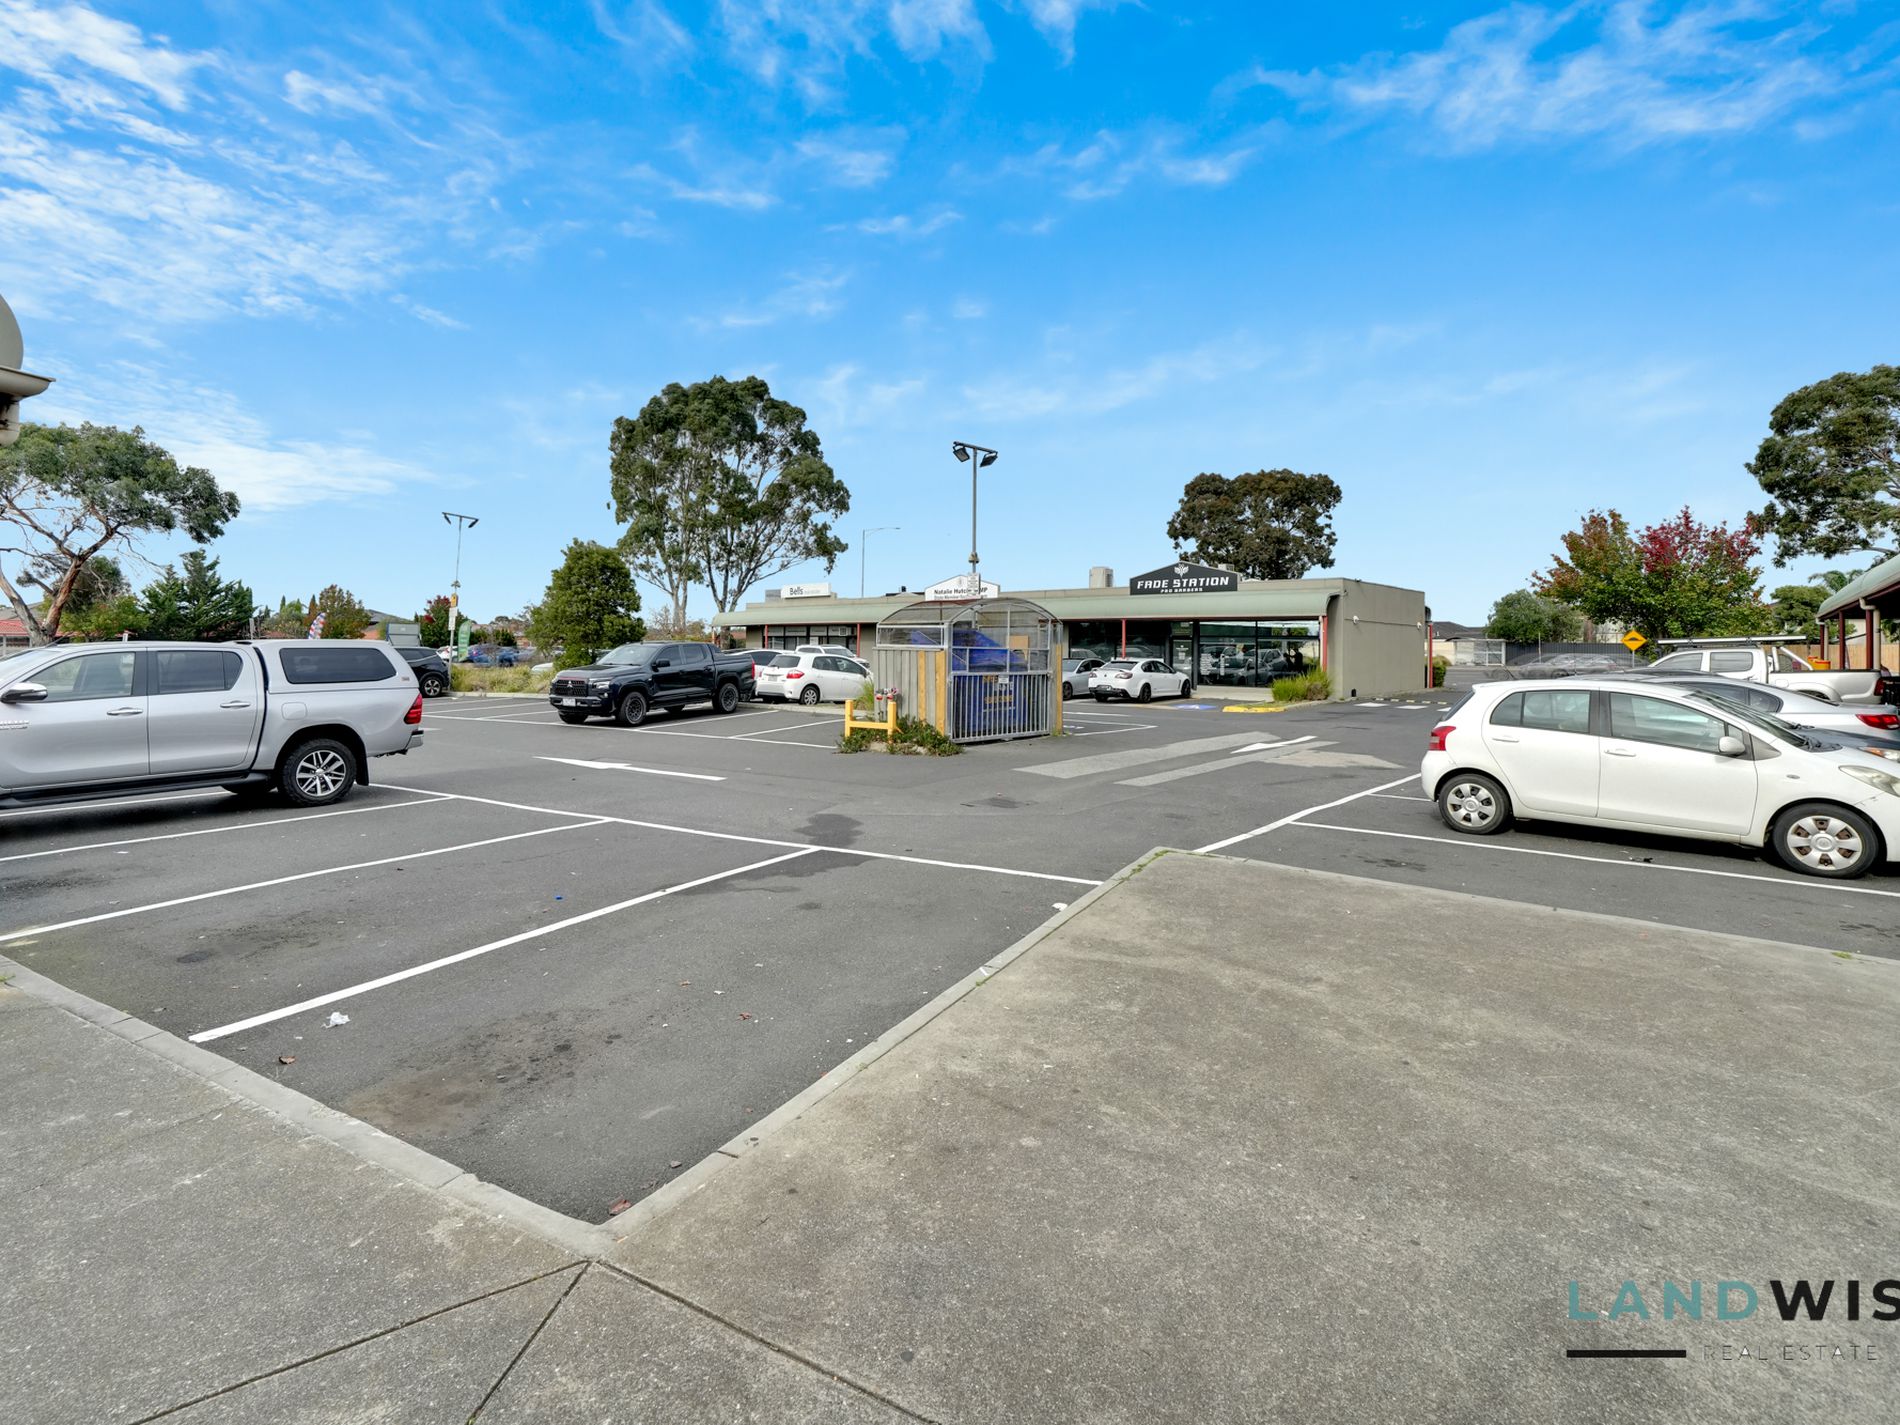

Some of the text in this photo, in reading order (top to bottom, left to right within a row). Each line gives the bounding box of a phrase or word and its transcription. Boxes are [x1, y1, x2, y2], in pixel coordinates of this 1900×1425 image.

[1137, 576, 1229, 590] FADE STATION
[789, 586, 804, 595] Bells
